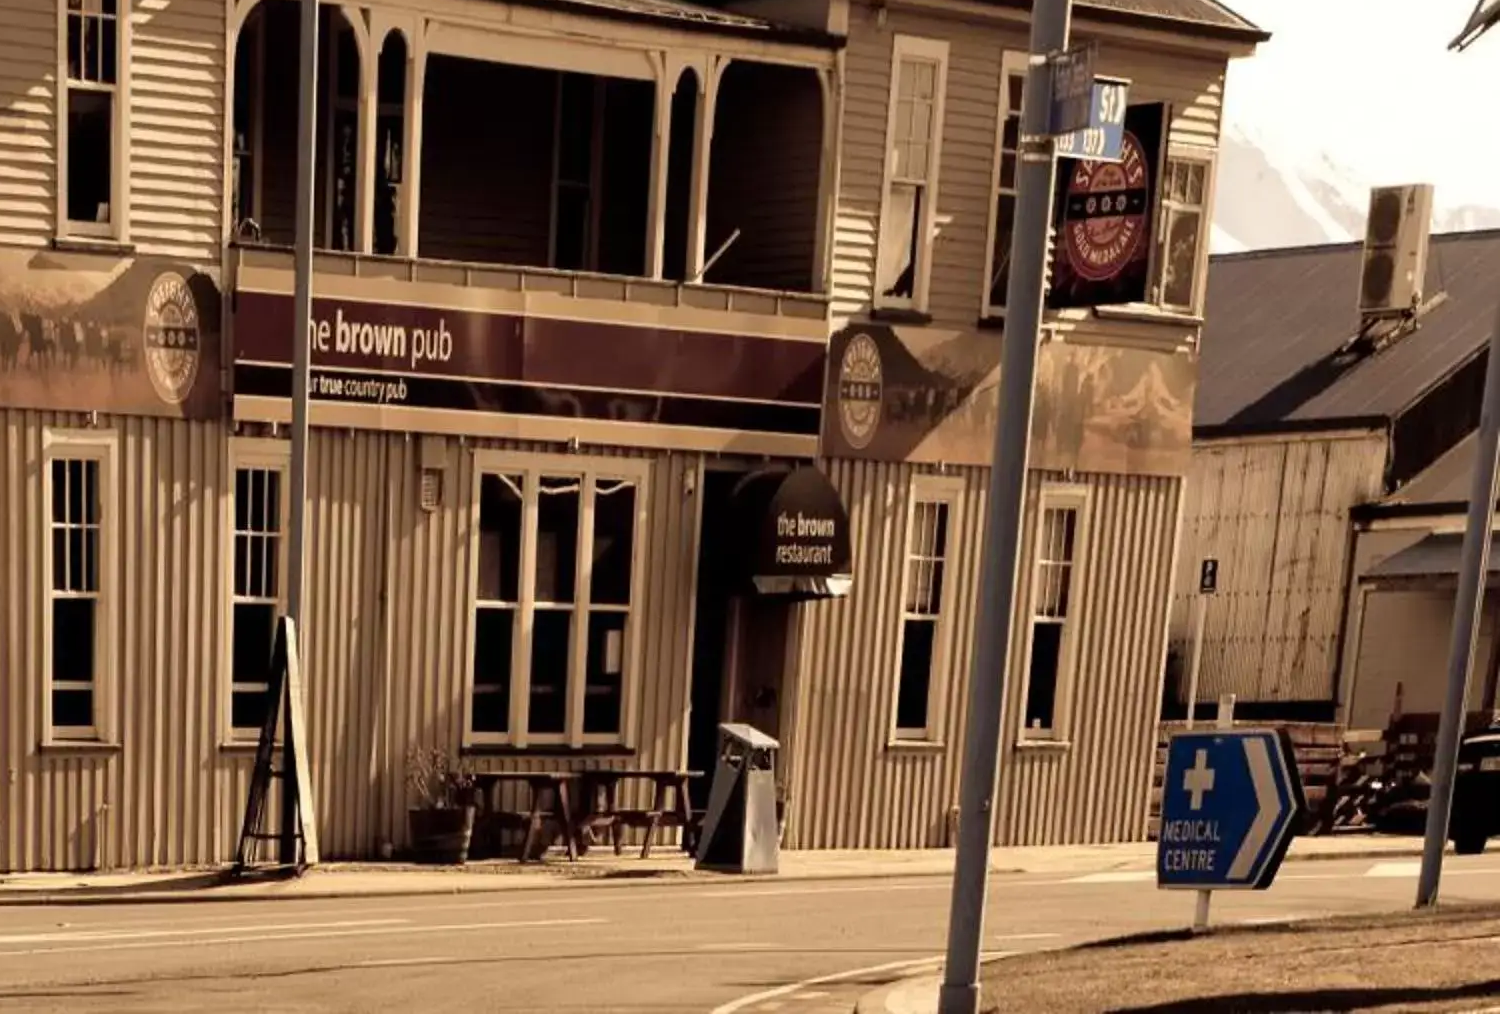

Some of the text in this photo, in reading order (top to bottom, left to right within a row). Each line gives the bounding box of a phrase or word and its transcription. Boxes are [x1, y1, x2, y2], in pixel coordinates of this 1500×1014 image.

[308, 308, 453, 370] he brown pub
[319, 375, 343, 395] true
[345, 378, 384, 403] country
[385, 379, 408, 402] pub
[777, 510, 835, 537] the brown
[776, 543, 833, 564] restaurant
[1163, 819, 1221, 843] MEDICAL
[1164, 849, 1216, 872] CENTRE
